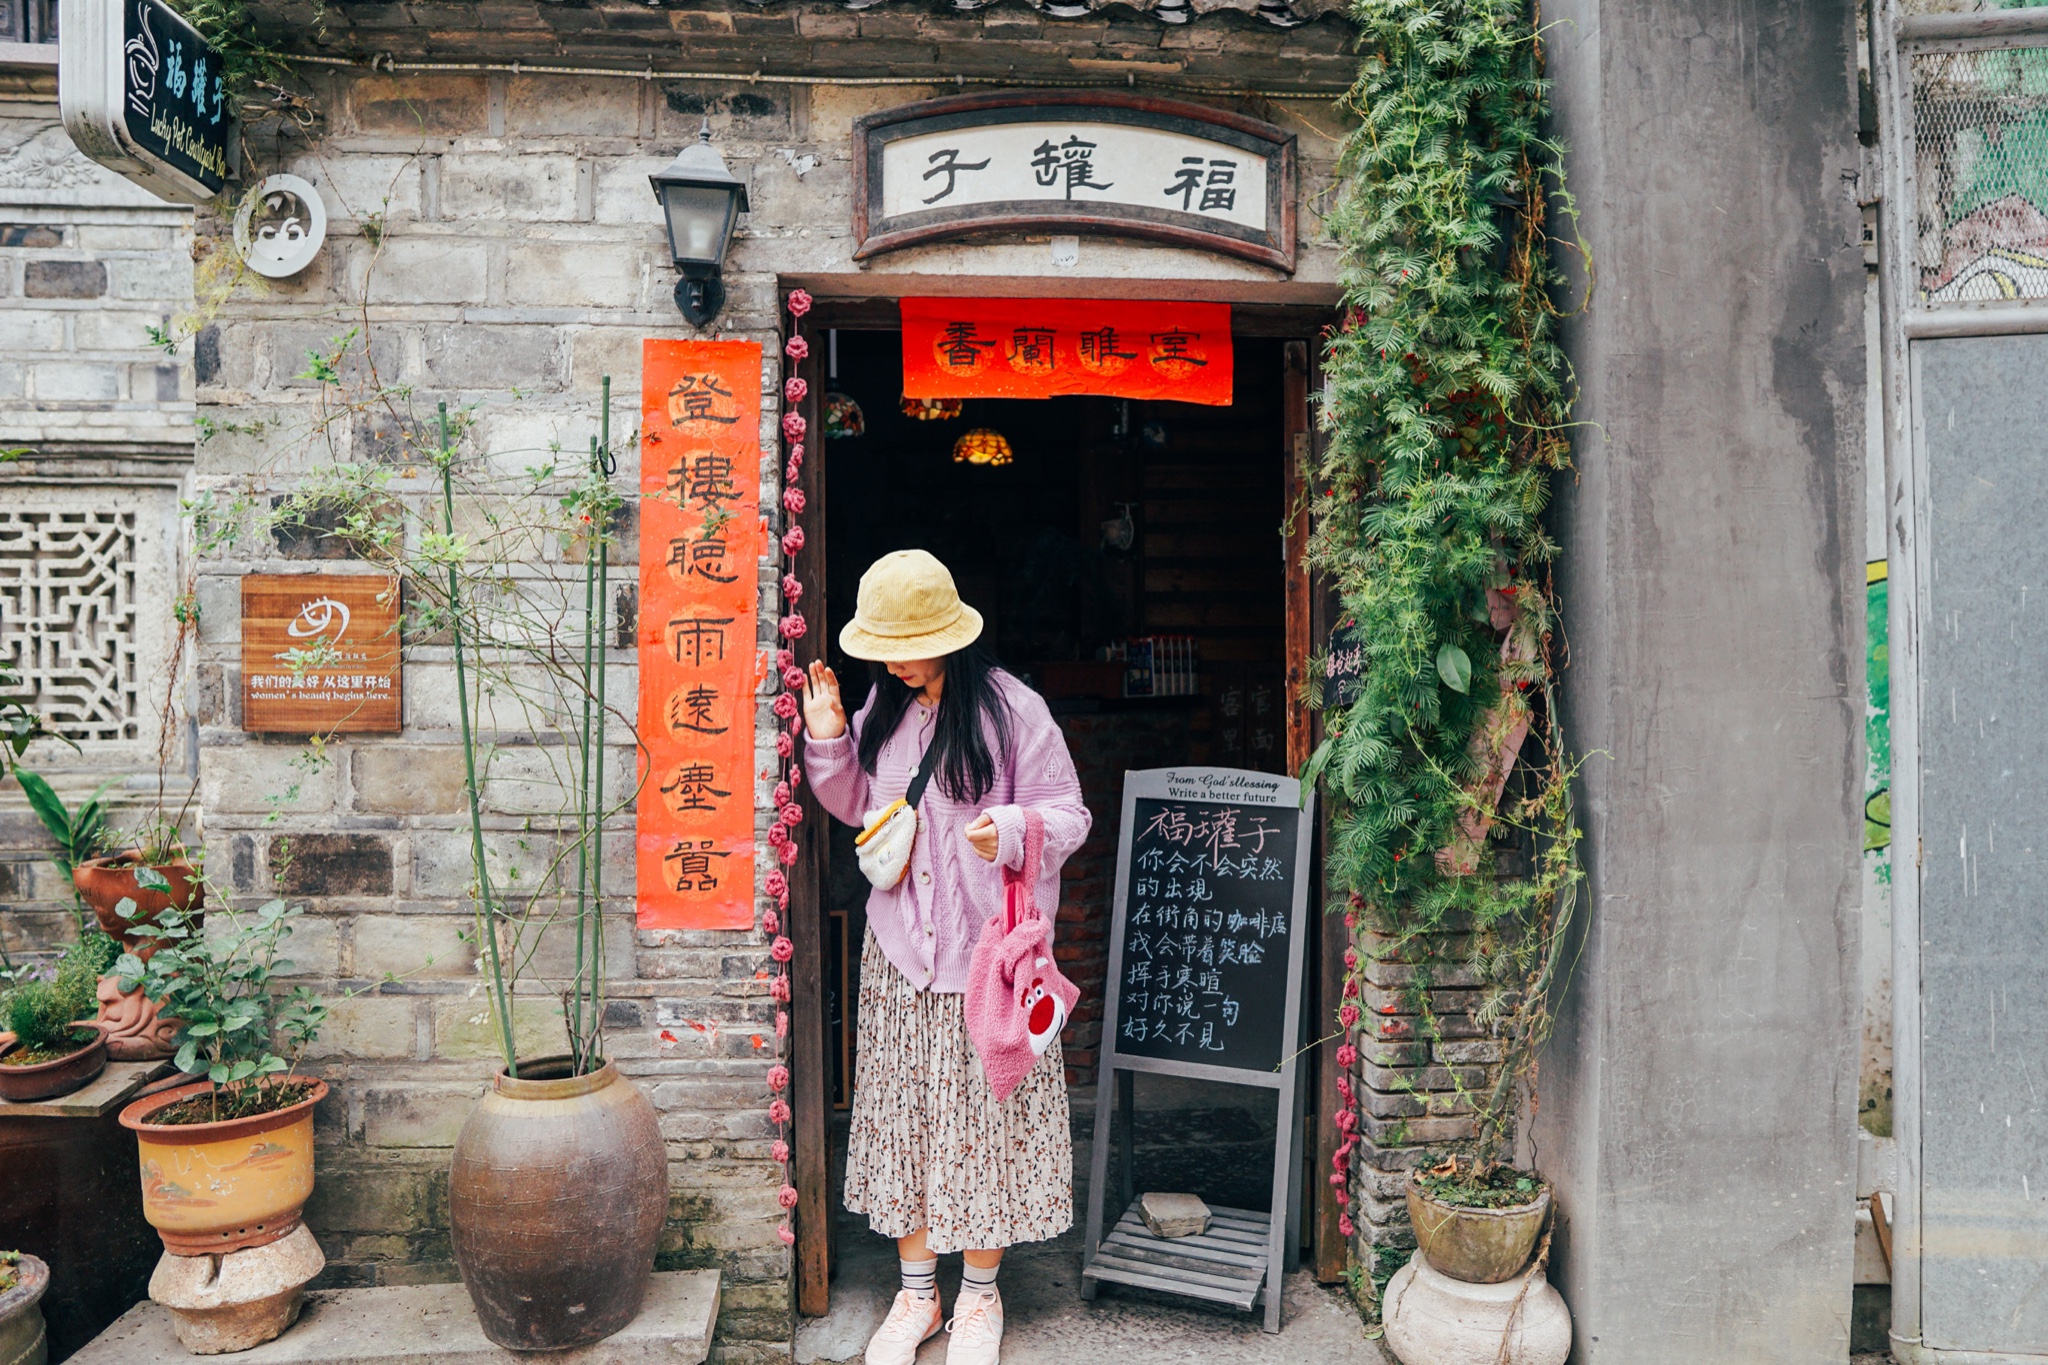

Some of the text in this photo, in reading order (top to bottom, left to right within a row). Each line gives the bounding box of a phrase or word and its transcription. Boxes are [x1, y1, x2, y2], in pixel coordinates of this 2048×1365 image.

[151, 102, 171, 155] Lucky
[172, 115, 185, 152] Pot
[299, 690, 331, 701] beauty
[333, 690, 364, 701] begins
[1166, 772, 1196, 785] From
[1168, 787, 1277, 803] Write a better future
[1138, 847, 1283, 881] 你会不会突然
[1127, 961, 1223, 995] 挥手寒暄
[1126, 990, 1239, 1026] 对你说一句
